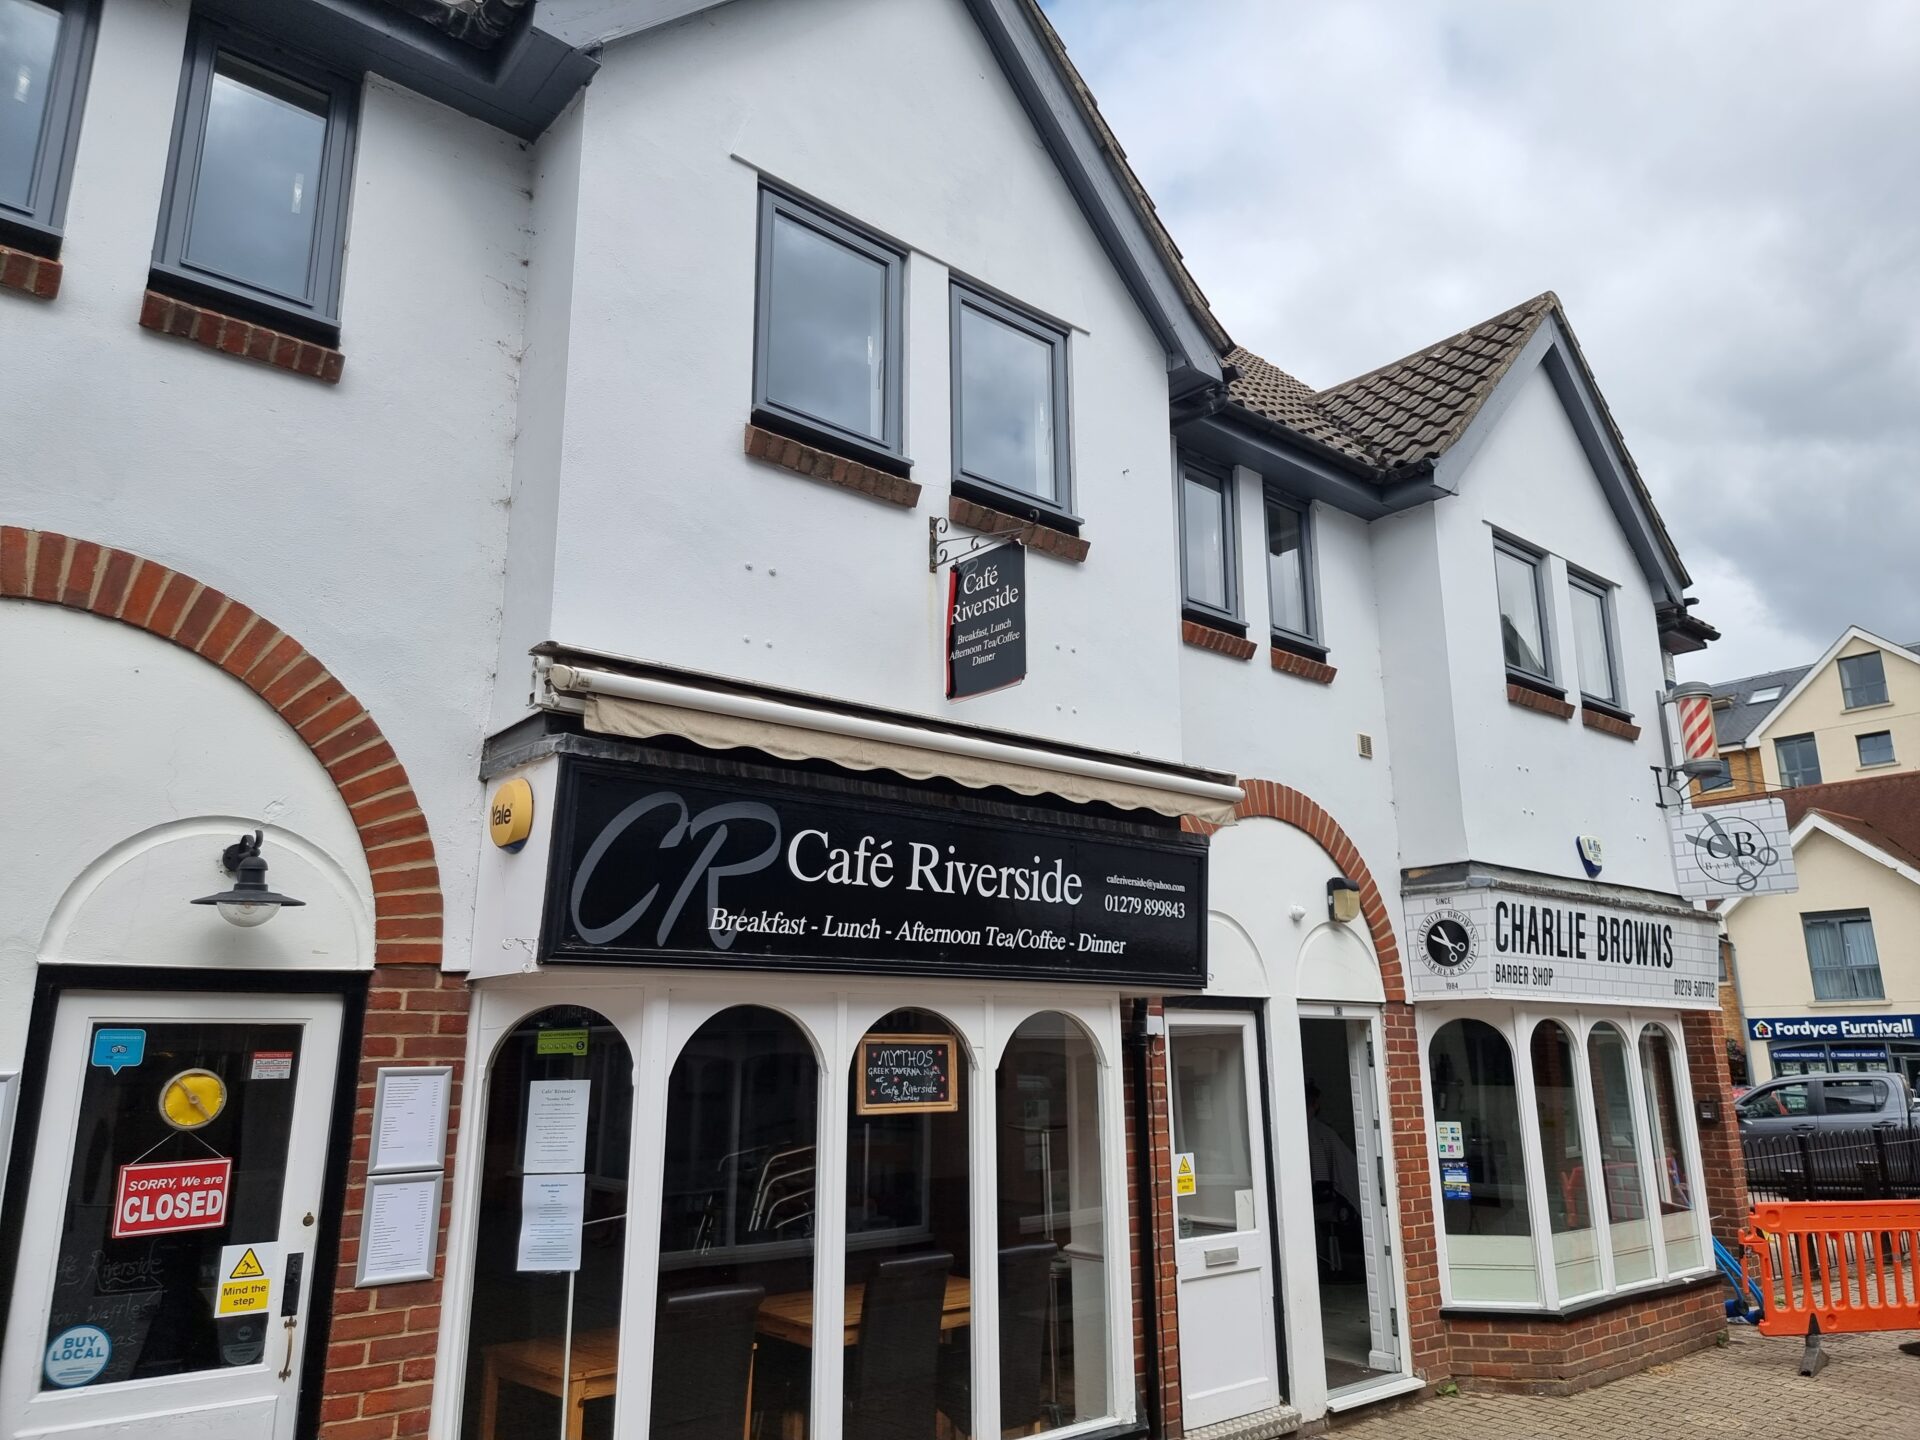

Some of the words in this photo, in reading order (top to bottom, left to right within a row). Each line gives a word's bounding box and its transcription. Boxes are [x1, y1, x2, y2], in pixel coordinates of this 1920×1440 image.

[963, 564, 998, 595] Café
[951, 585, 1019, 625] Riverside
[957, 628, 989, 645] Breakfast,
[990, 618, 1012, 634] Lunch
[950, 644, 982, 660] Afternoon
[983, 631, 1020, 650] Tea/Coffee
[972, 652, 996, 666] Dinner
[492, 804, 511, 826] Yale
[1706, 831, 1757, 860] CB
[788, 829, 894, 889] Café
[906, 842, 1083, 905] Riverside
[1106, 874, 1186, 893] caferiverside@yahoo.com
[1104, 894, 1142, 914] 01279
[1144, 898, 1186, 919] 899843
[1435, 897, 1452, 905] SINCE
[708, 907, 807, 935] Breakfast
[822, 915, 881, 939] Lunch
[895, 921, 981, 945] Afternoon
[986, 926, 1066, 950] Tea/Coffee
[1077, 933, 1126, 954] Dinner
[1418, 911, 1444, 944] CHARLIE
[1447, 911, 1477, 940] BROWNS
[1495, 901, 1587, 960] CHARLIE
[1597, 915, 1674, 969] BROWNS
[1422, 953, 1455, 975] BARBER
[1457, 950, 1477, 973] SHOP
[1495, 963, 1529, 985] BARBER
[1532, 968, 1554, 987] SHOP
[1446, 982, 1458, 990] 1984
[1674, 979, 1692, 996] 01279
[1694, 981, 1715, 998] 507712
[1774, 1021, 1838, 1038] Fordyce
[1840, 1018, 1914, 1034] Furnivall
[578, 1041, 584, 1049] 5
[878, 1050, 933, 1067] MYTHOS
[868, 1067, 889, 1076] GREEK
[891, 1067, 922, 1076] TAVERNA
[902, 1081, 938, 1096] Riverside
[128, 1178, 177, 1192] SORRY,
[181, 1176, 201, 1187] We
[203, 1175, 223, 1184] are
[123, 1189, 223, 1224] CLOSED
[223, 1286, 248, 1296] Mind
[251, 1284, 266, 1293] the
[233, 1297, 255, 1306] step
[63, 1336, 98, 1349] BUY
[52, 1347, 104, 1360] LOCAL
